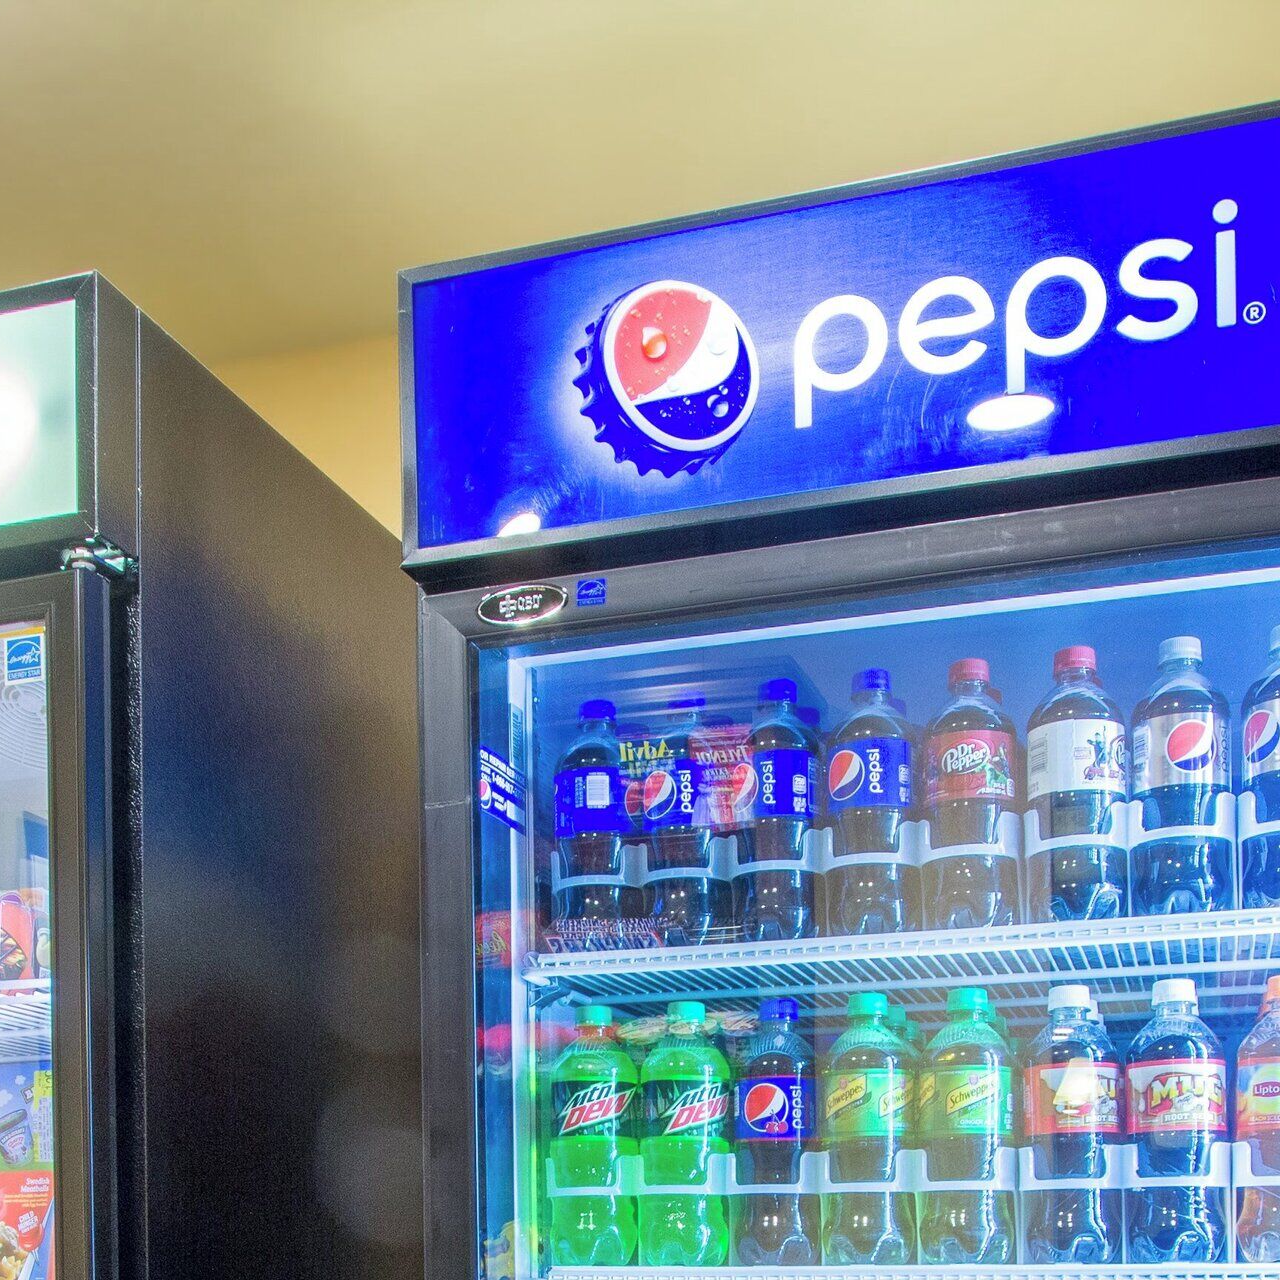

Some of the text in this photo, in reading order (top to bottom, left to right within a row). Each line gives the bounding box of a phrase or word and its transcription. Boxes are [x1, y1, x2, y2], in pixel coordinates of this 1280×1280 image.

[794, 199, 1239, 428] pepsi
[867, 748, 883, 794] pepsi
[944, 747, 988, 774] Pepper
[957, 743, 977, 758] Dr
[678, 770, 694, 813] pepsi
[760, 760, 777, 804] pepsi
[790, 1085, 804, 1129] pepsi
[1164, 1113, 1190, 1122] ROOT
